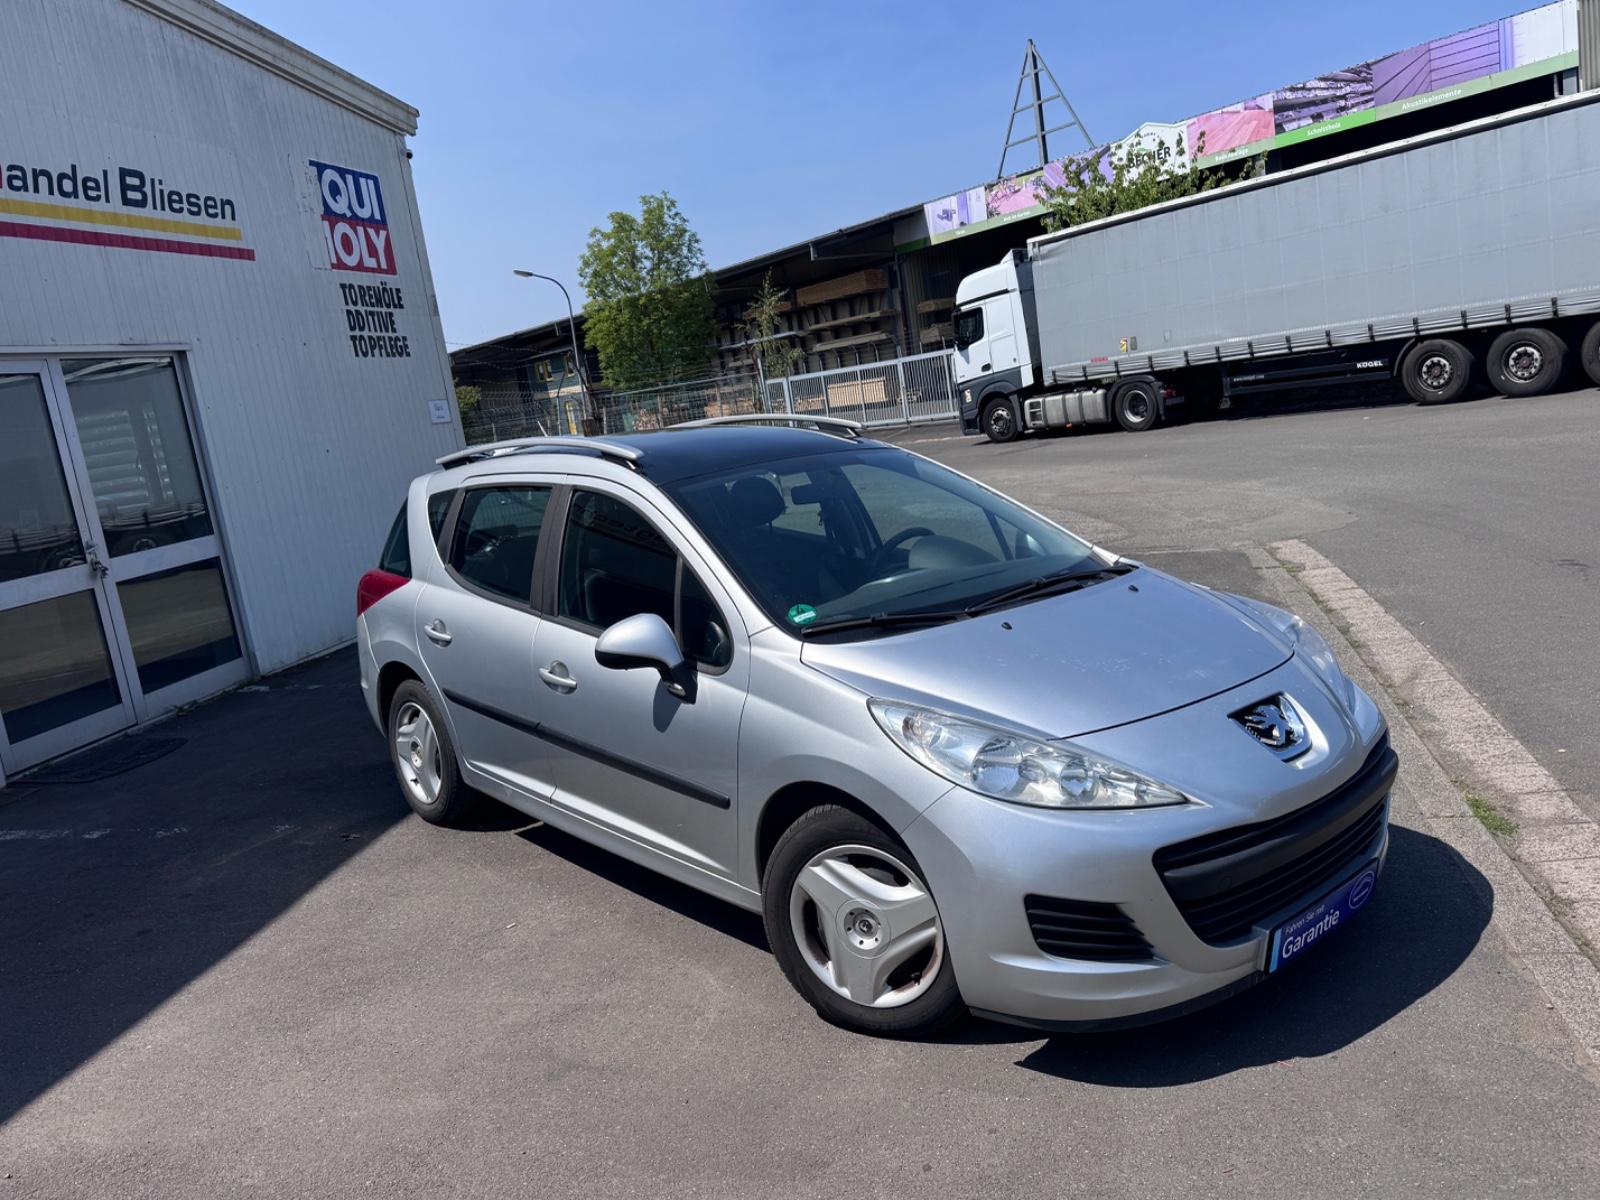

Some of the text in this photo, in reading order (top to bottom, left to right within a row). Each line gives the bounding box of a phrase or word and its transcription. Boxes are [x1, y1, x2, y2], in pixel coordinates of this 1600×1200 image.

[0, 163, 237, 222] andel Bliesen
[1282, 908, 1340, 959] Garantie
